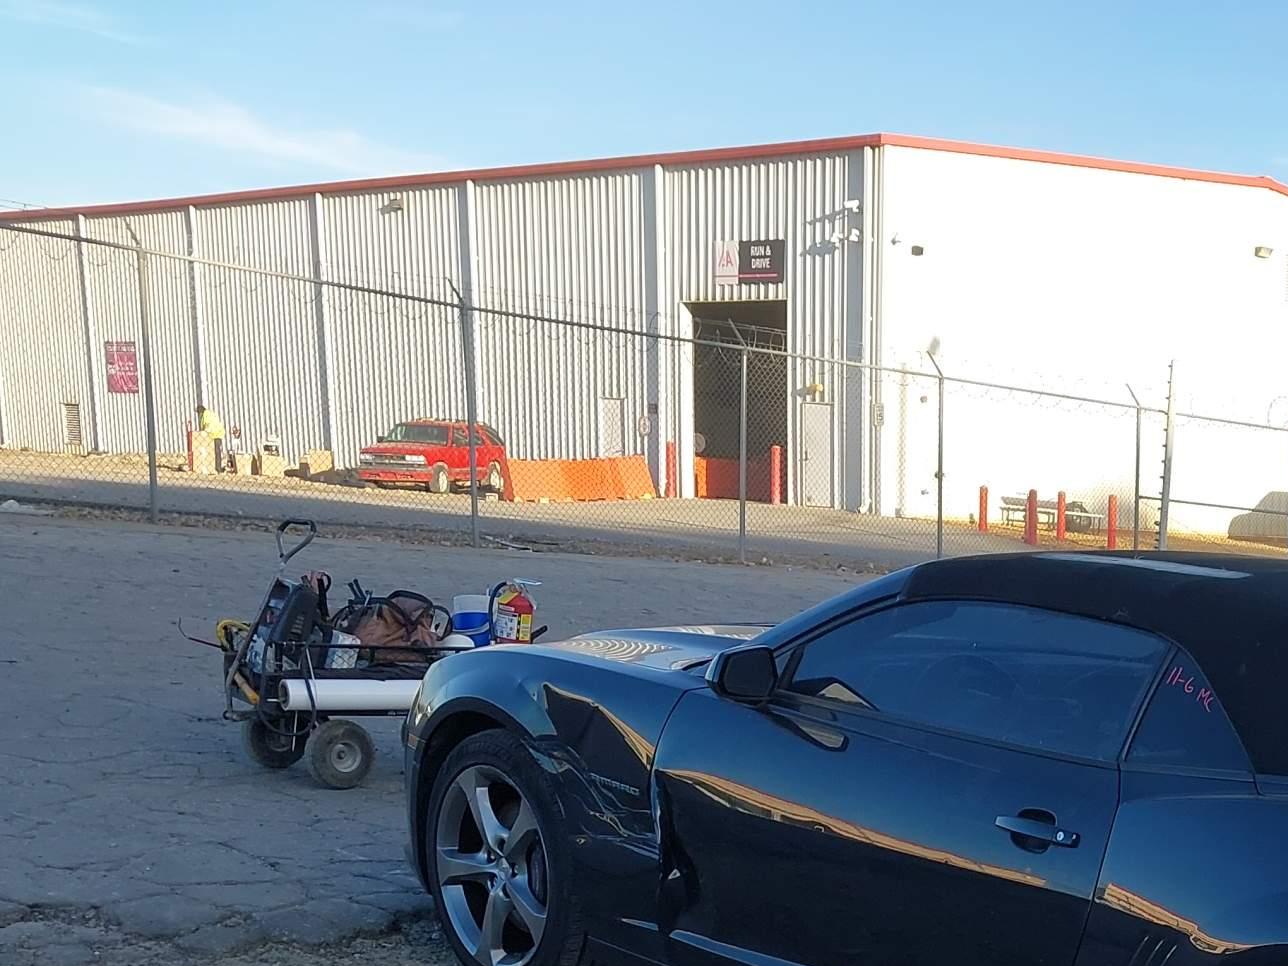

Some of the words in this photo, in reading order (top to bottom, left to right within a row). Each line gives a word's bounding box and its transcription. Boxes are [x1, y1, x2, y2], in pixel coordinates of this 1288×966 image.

[750, 245, 765, 257] RUN
[765, 245, 772, 256] &
[751, 258, 771, 269] DRIVE
[1166, 666, 1195, 693] 11-6
